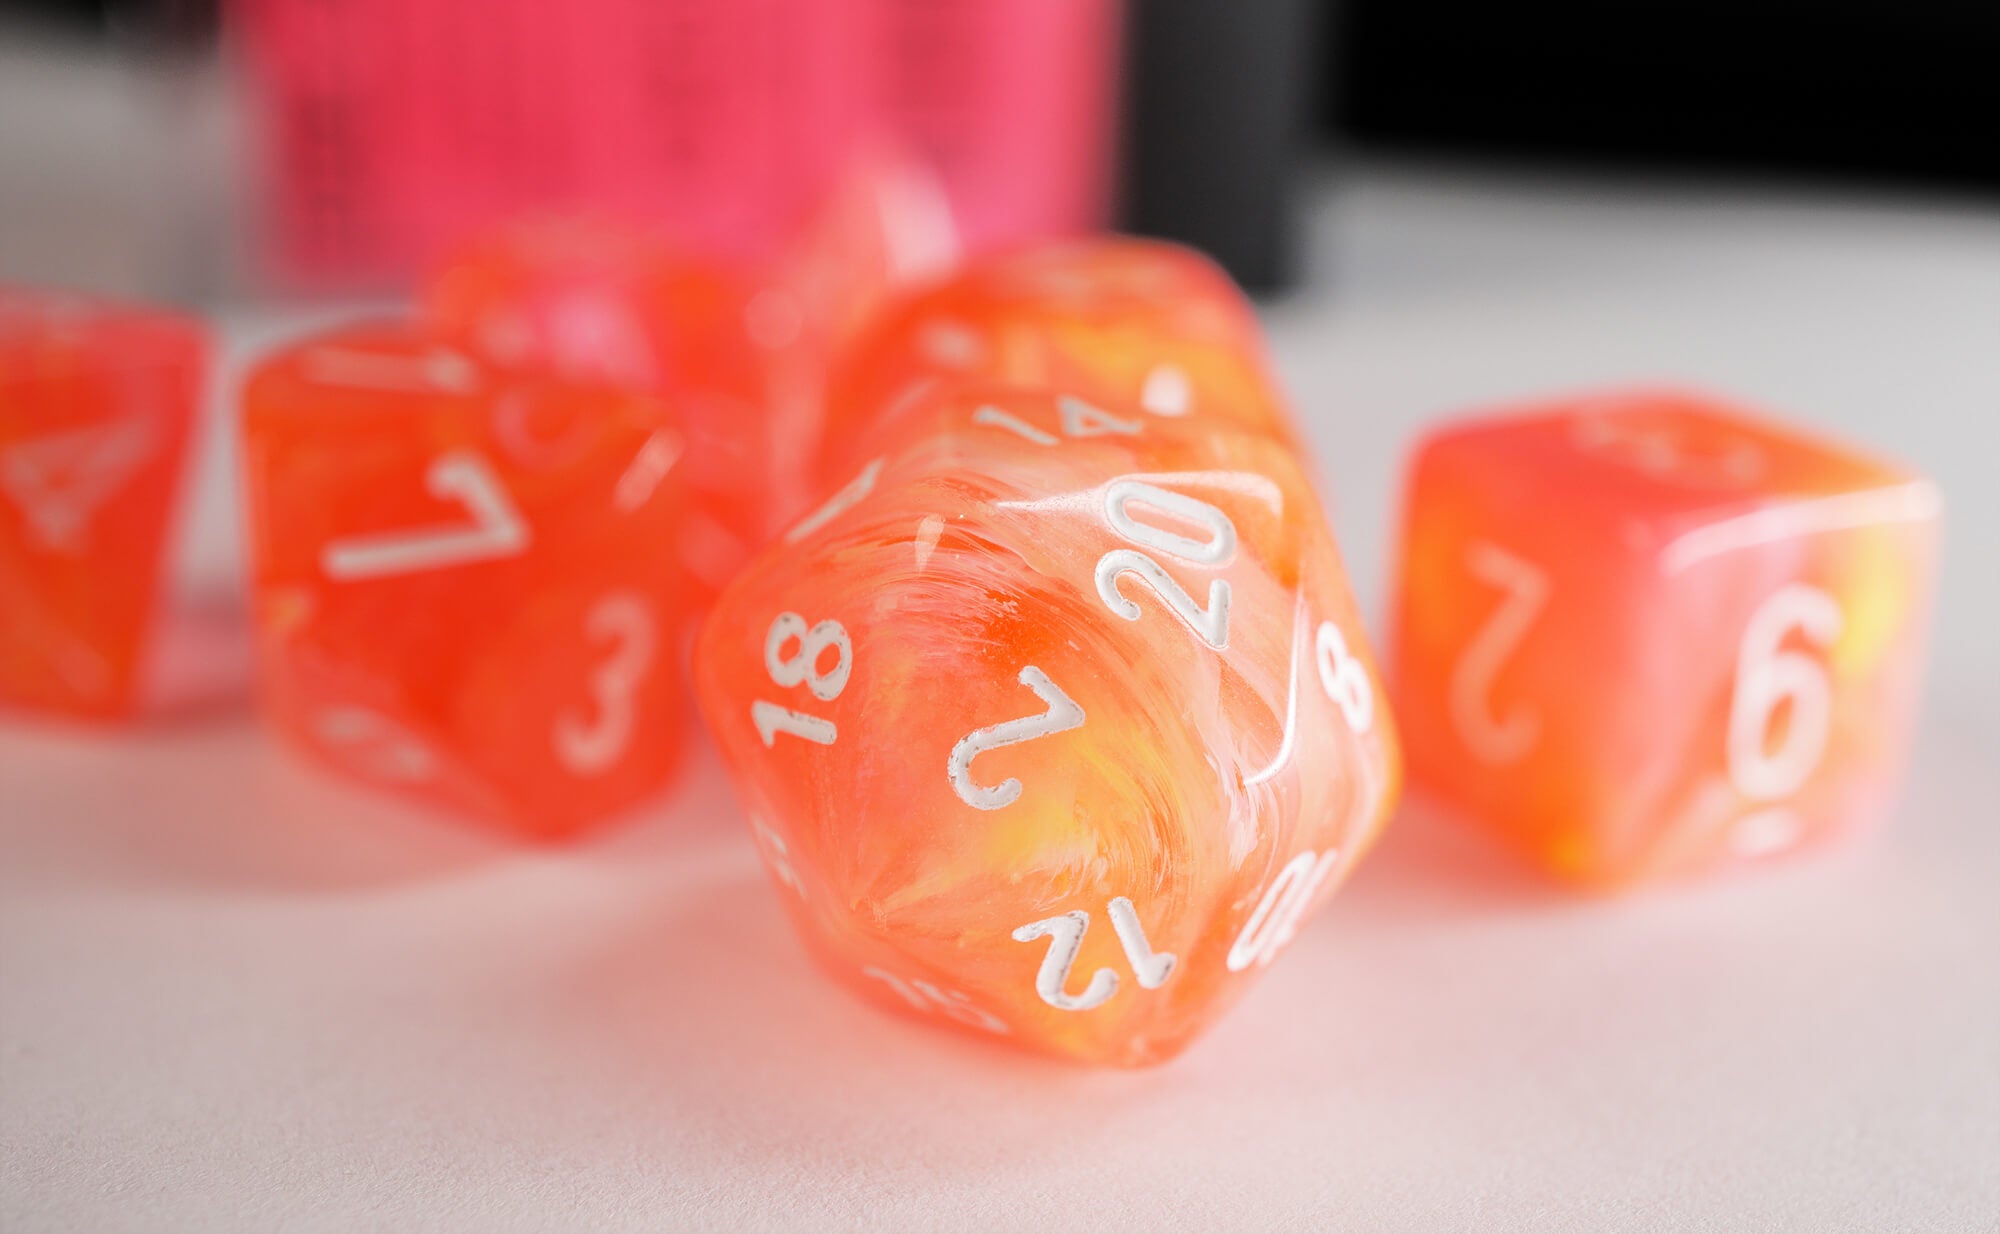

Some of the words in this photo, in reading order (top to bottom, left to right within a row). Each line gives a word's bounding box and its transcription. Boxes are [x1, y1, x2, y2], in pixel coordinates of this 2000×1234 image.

[972, 395, 1144, 446] 14
[1095, 481, 1237, 650] 20
[557, 600, 657, 775] 3
[752, 611, 852, 747] 18
[1316, 621, 1373, 734] 8
[1450, 540, 1553, 768] 2
[1727, 583, 1845, 800] 6
[948, 665, 1085, 810] 2
[1012, 896, 1177, 1010] 12
[1227, 848, 1339, 971] 10
